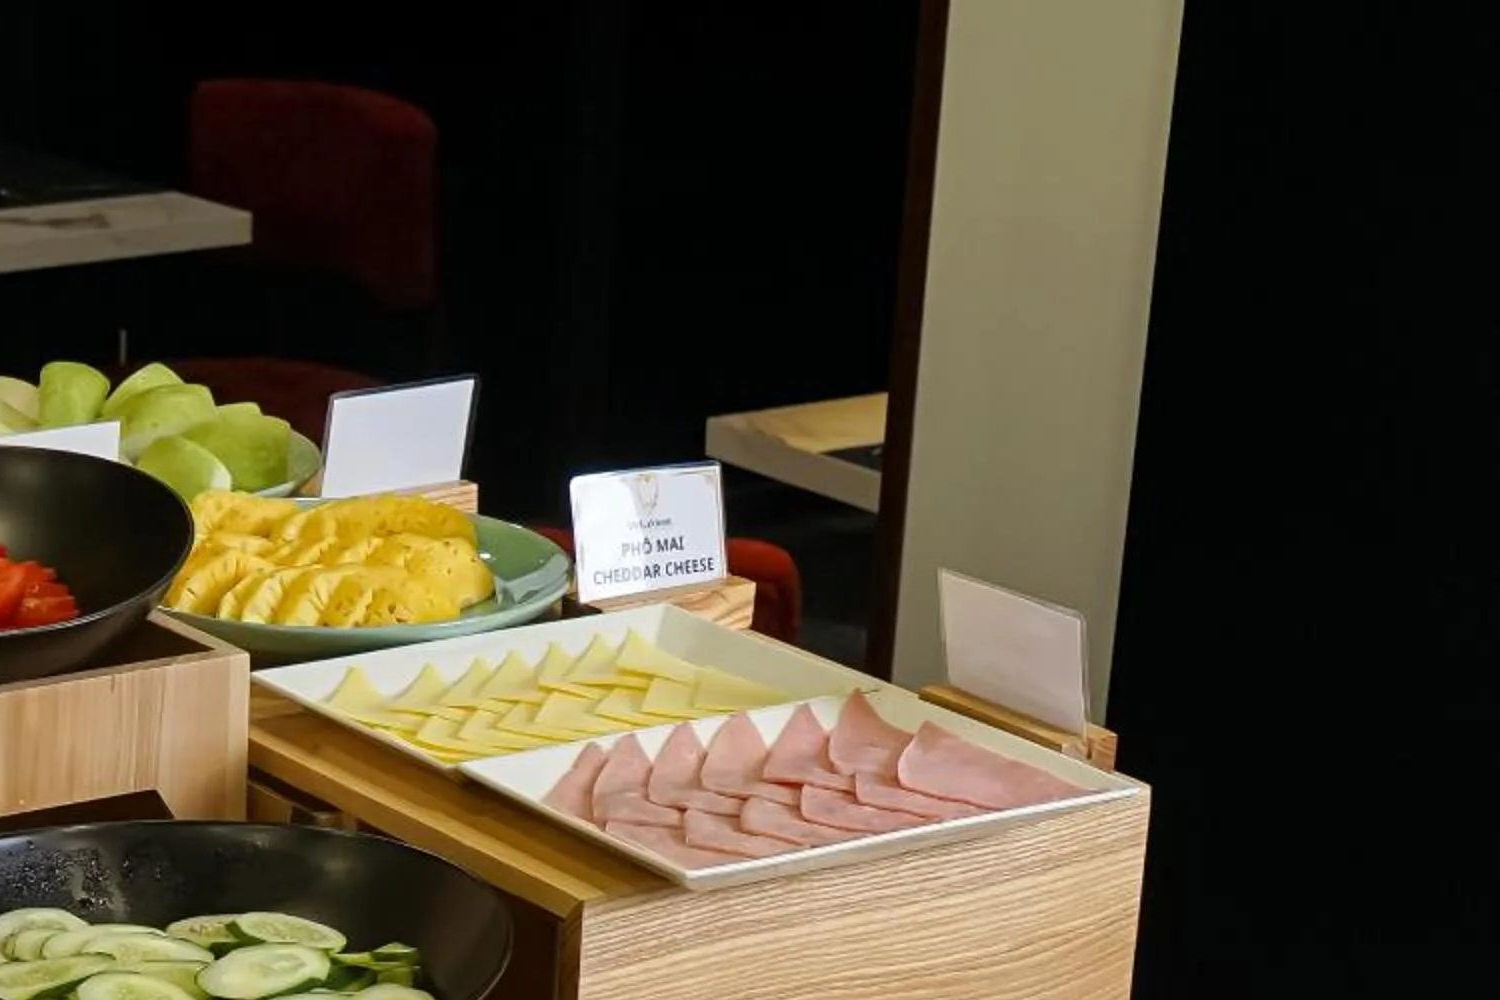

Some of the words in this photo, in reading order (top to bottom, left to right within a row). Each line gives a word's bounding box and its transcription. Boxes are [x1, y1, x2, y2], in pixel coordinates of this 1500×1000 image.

[656, 535, 685, 552] MAI
[593, 564, 661, 585] CHEDDAR
[665, 557, 715, 577] CHEESE
